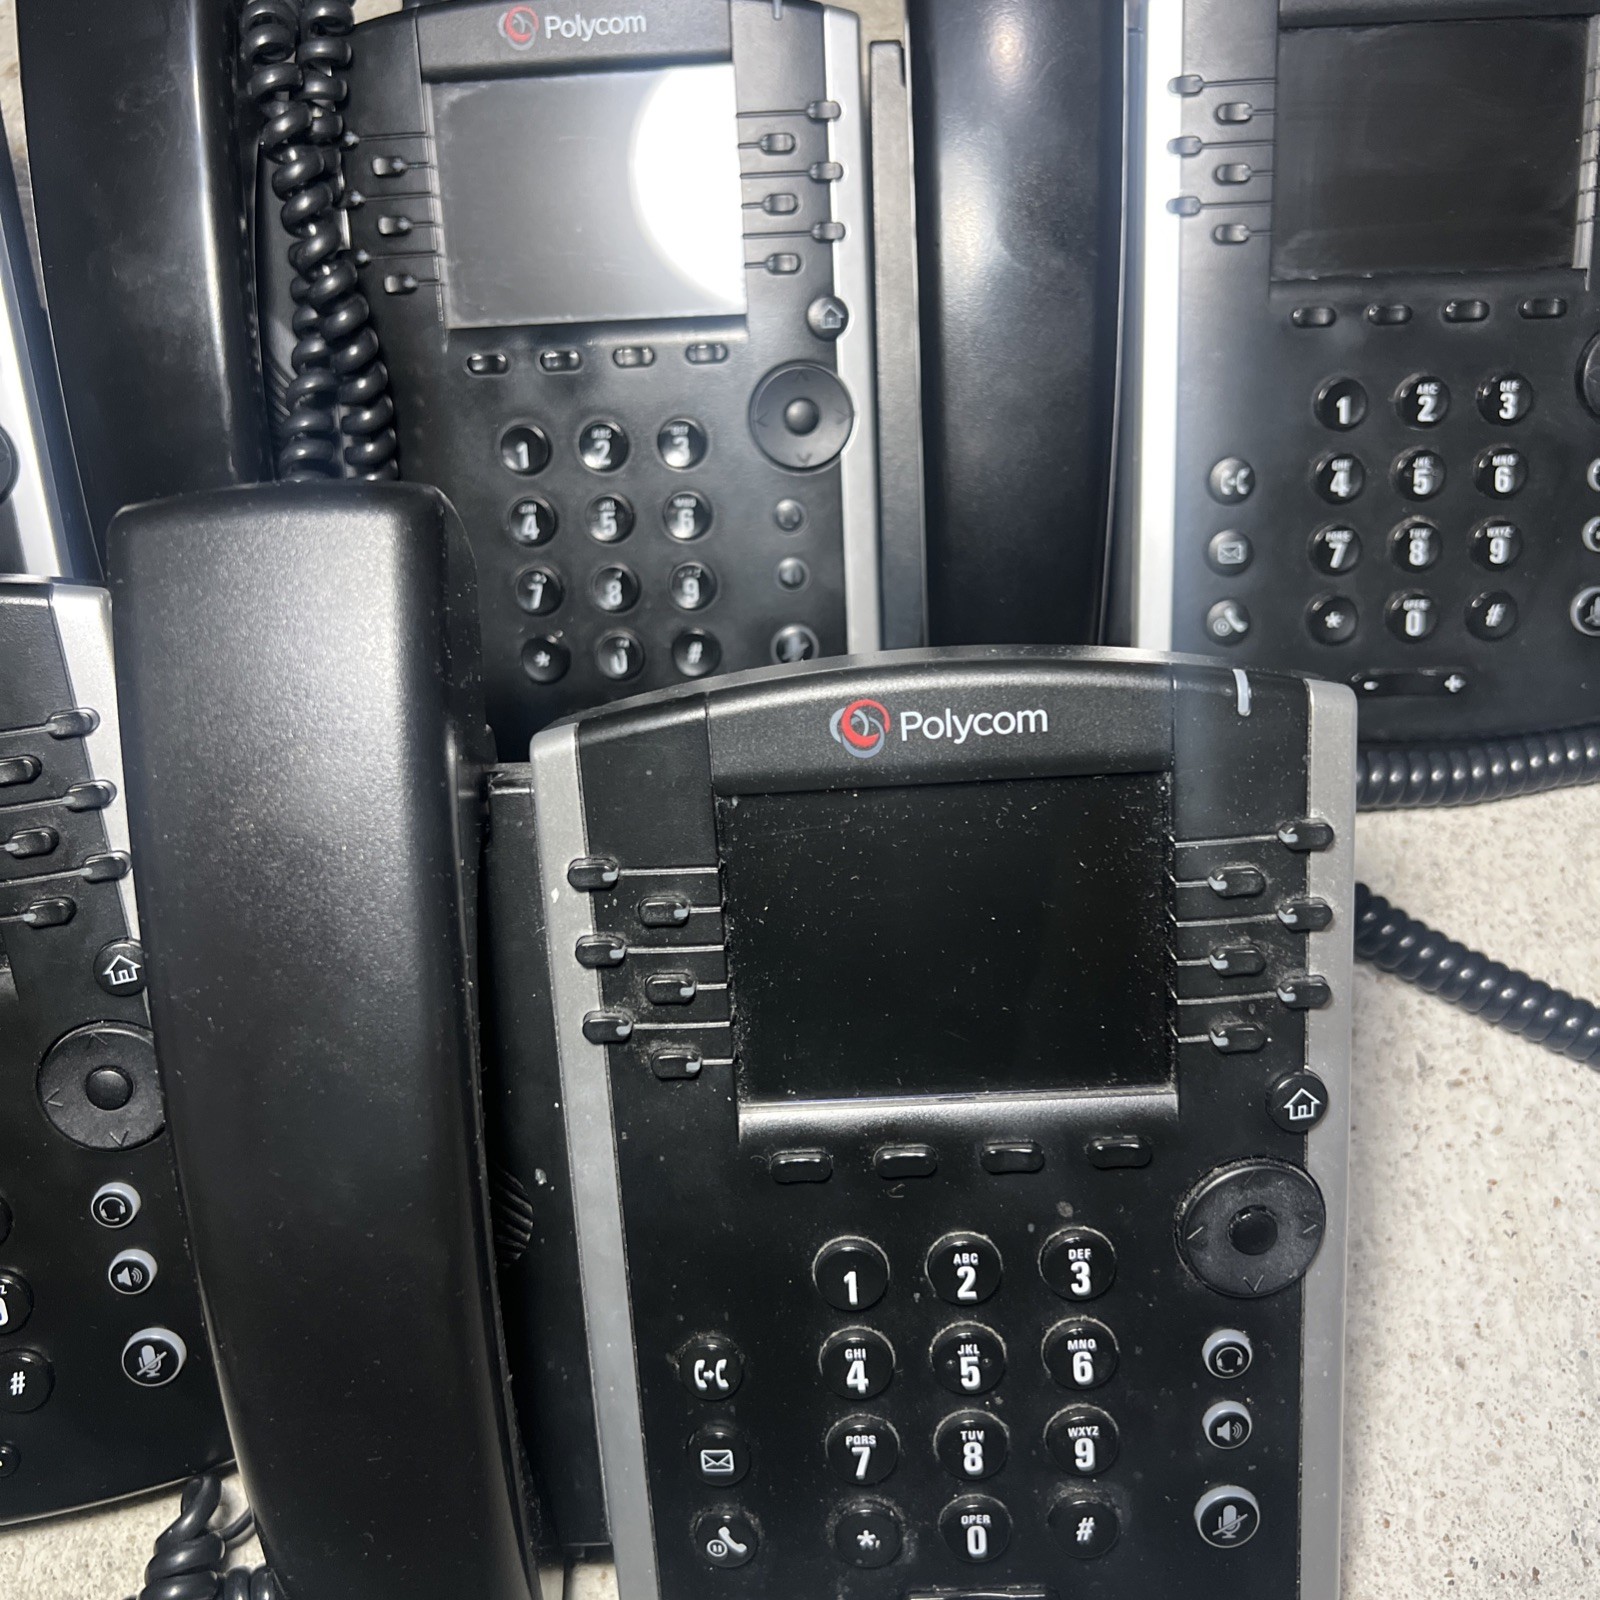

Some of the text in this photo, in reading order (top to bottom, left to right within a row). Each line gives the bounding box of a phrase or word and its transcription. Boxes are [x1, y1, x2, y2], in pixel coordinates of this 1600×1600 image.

[544, 13, 646, 42] Polycom
[1336, 395, 1351, 425] 1
[1417, 395, 1438, 422] 2
[1498, 393, 1519, 420] 3
[515, 440, 530, 469] 1
[594, 440, 612, 466] 2
[673, 437, 690, 467] 3
[1330, 471, 1352, 498] 4
[1413, 469, 1434, 495] 5
[1494, 466, 1515, 493] 6
[521, 514, 540, 540] 4
[600, 511, 618, 537] 5
[677, 509, 695, 538] 6
[1328, 541, 1347, 569] 7
[1408, 539, 1430, 566] 8
[1489, 538, 1510, 565] 9
[528, 583, 544, 610] 7
[606, 580, 623, 606] 8
[683, 578, 700, 604] 9
[1405, 610, 1426, 637] 0
[899, 707, 1049, 744] Polycom
[953, 1252, 979, 1265] ABC
[1068, 1248, 1092, 1261] DEF
[843, 1271, 858, 1305] 1
[956, 1265, 978, 1301] 2
[1070, 1261, 1092, 1296] 3
[845, 1348, 867, 1361] GHI
[958, 1344, 980, 1356] JKL
[1067, 1339, 1097, 1351] MNO
[846, 1360, 869, 1393] 4
[960, 1356, 981, 1391] 5
[1072, 1351, 1094, 1386] 6
[10, 1371, 26, 1396] #
[845, 1434, 876, 1446] PQRS
[960, 1430, 985, 1442] TUV
[1068, 1426, 1100, 1438] WXYZ
[851, 1446, 871, 1479] 7
[963, 1442, 984, 1476] 8
[1074, 1438, 1096, 1471] 9
[961, 1514, 991, 1526] OPER
[1076, 1517, 1095, 1542] #
[966, 1525, 988, 1558] 0
